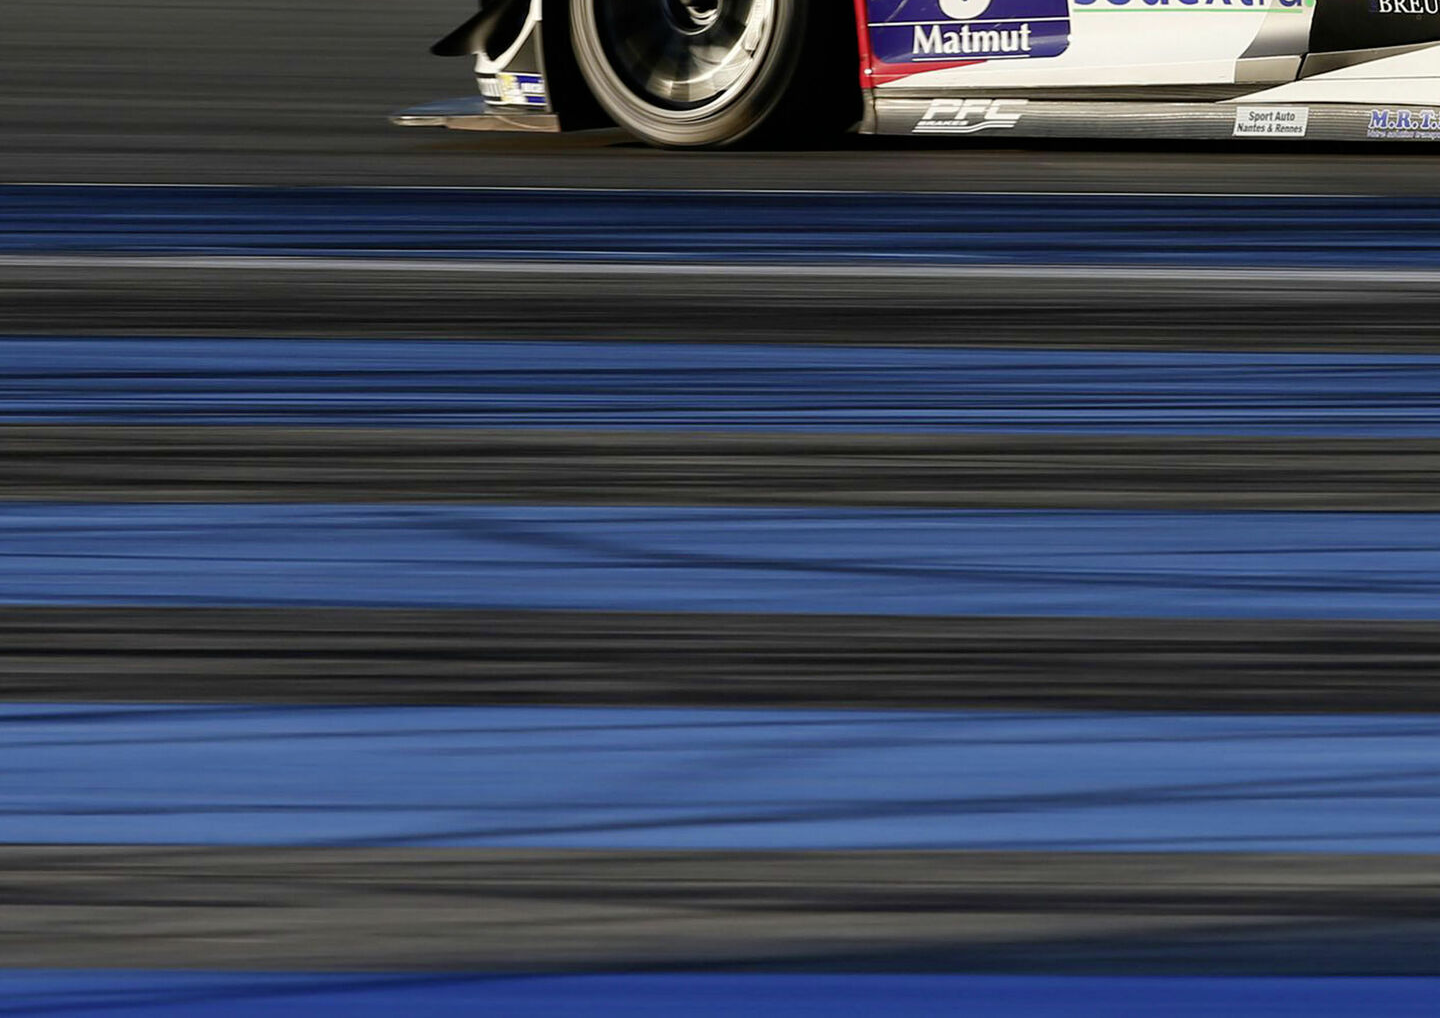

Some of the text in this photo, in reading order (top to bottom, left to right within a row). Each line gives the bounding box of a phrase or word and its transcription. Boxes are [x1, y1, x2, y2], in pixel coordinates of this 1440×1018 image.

[912, 23, 1032, 56] Matmut
[921, 98, 1030, 121] PFC
[1248, 110, 1297, 123] Sport Auto
[1236, 122, 1304, 134] Nantes & Rennes
